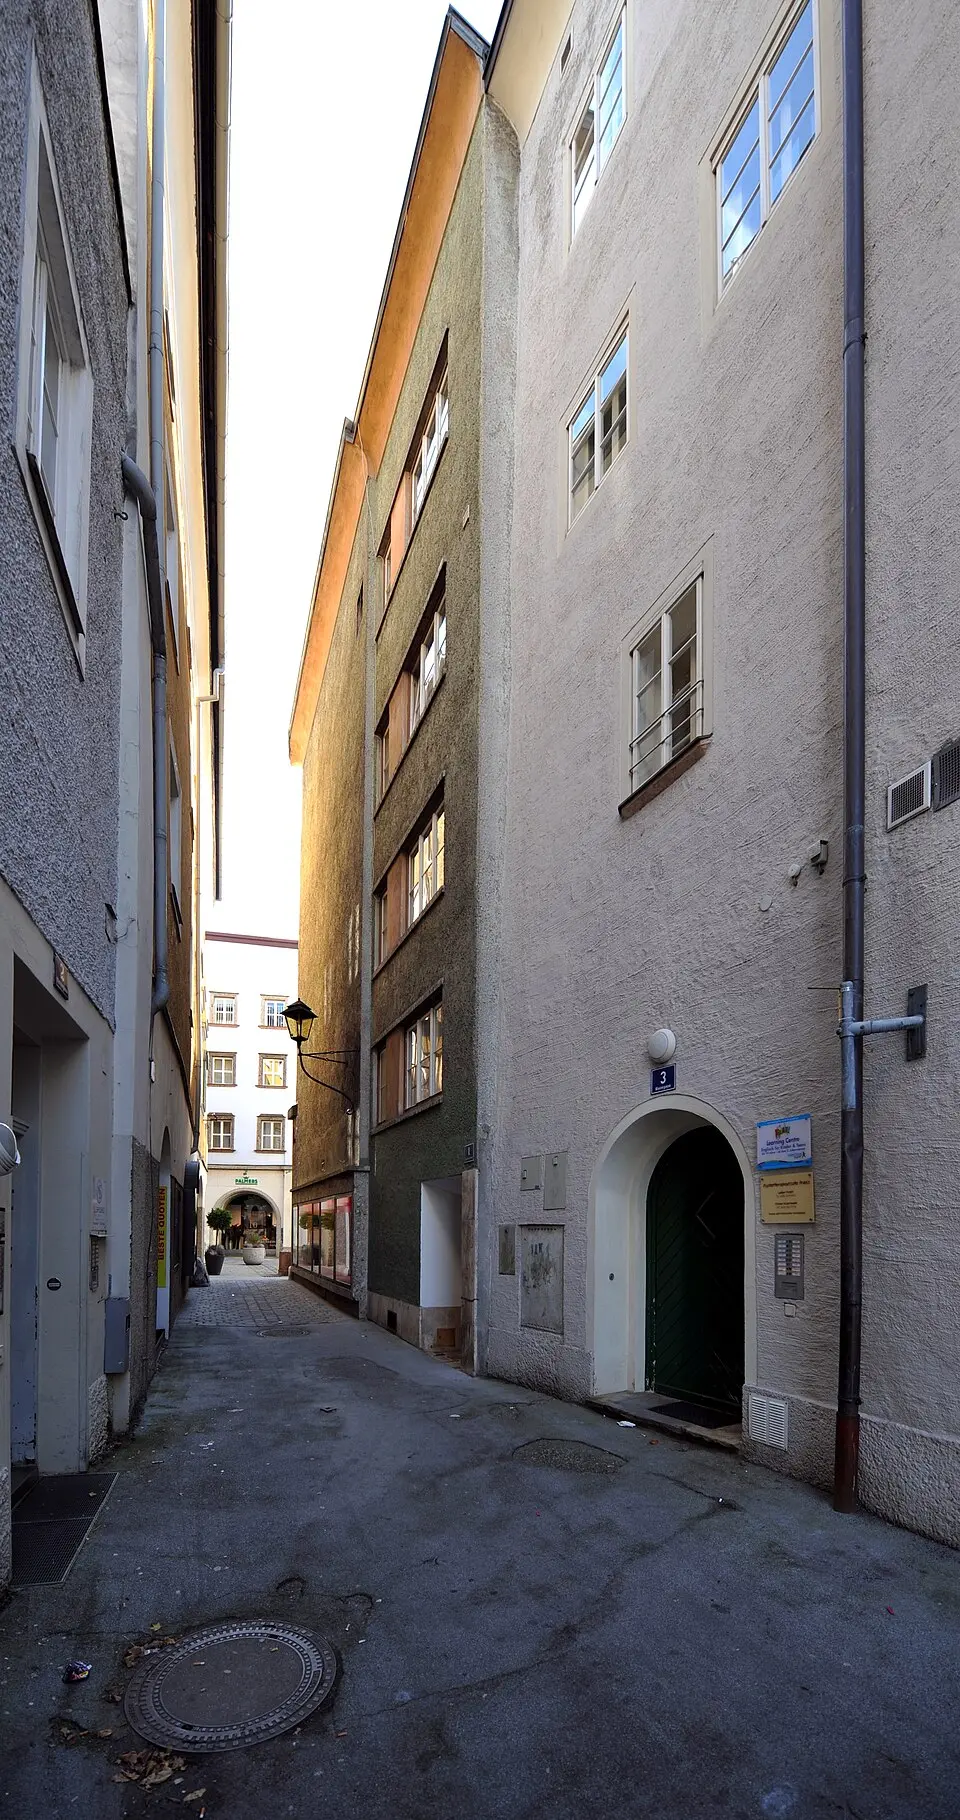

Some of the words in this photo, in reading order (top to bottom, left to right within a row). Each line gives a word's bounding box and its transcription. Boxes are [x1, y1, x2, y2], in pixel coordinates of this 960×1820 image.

[660, 1071, 666, 1084] 3
[158, 1188, 166, 1228] QUOTEN
[157, 1230, 165, 1261] BESTE
